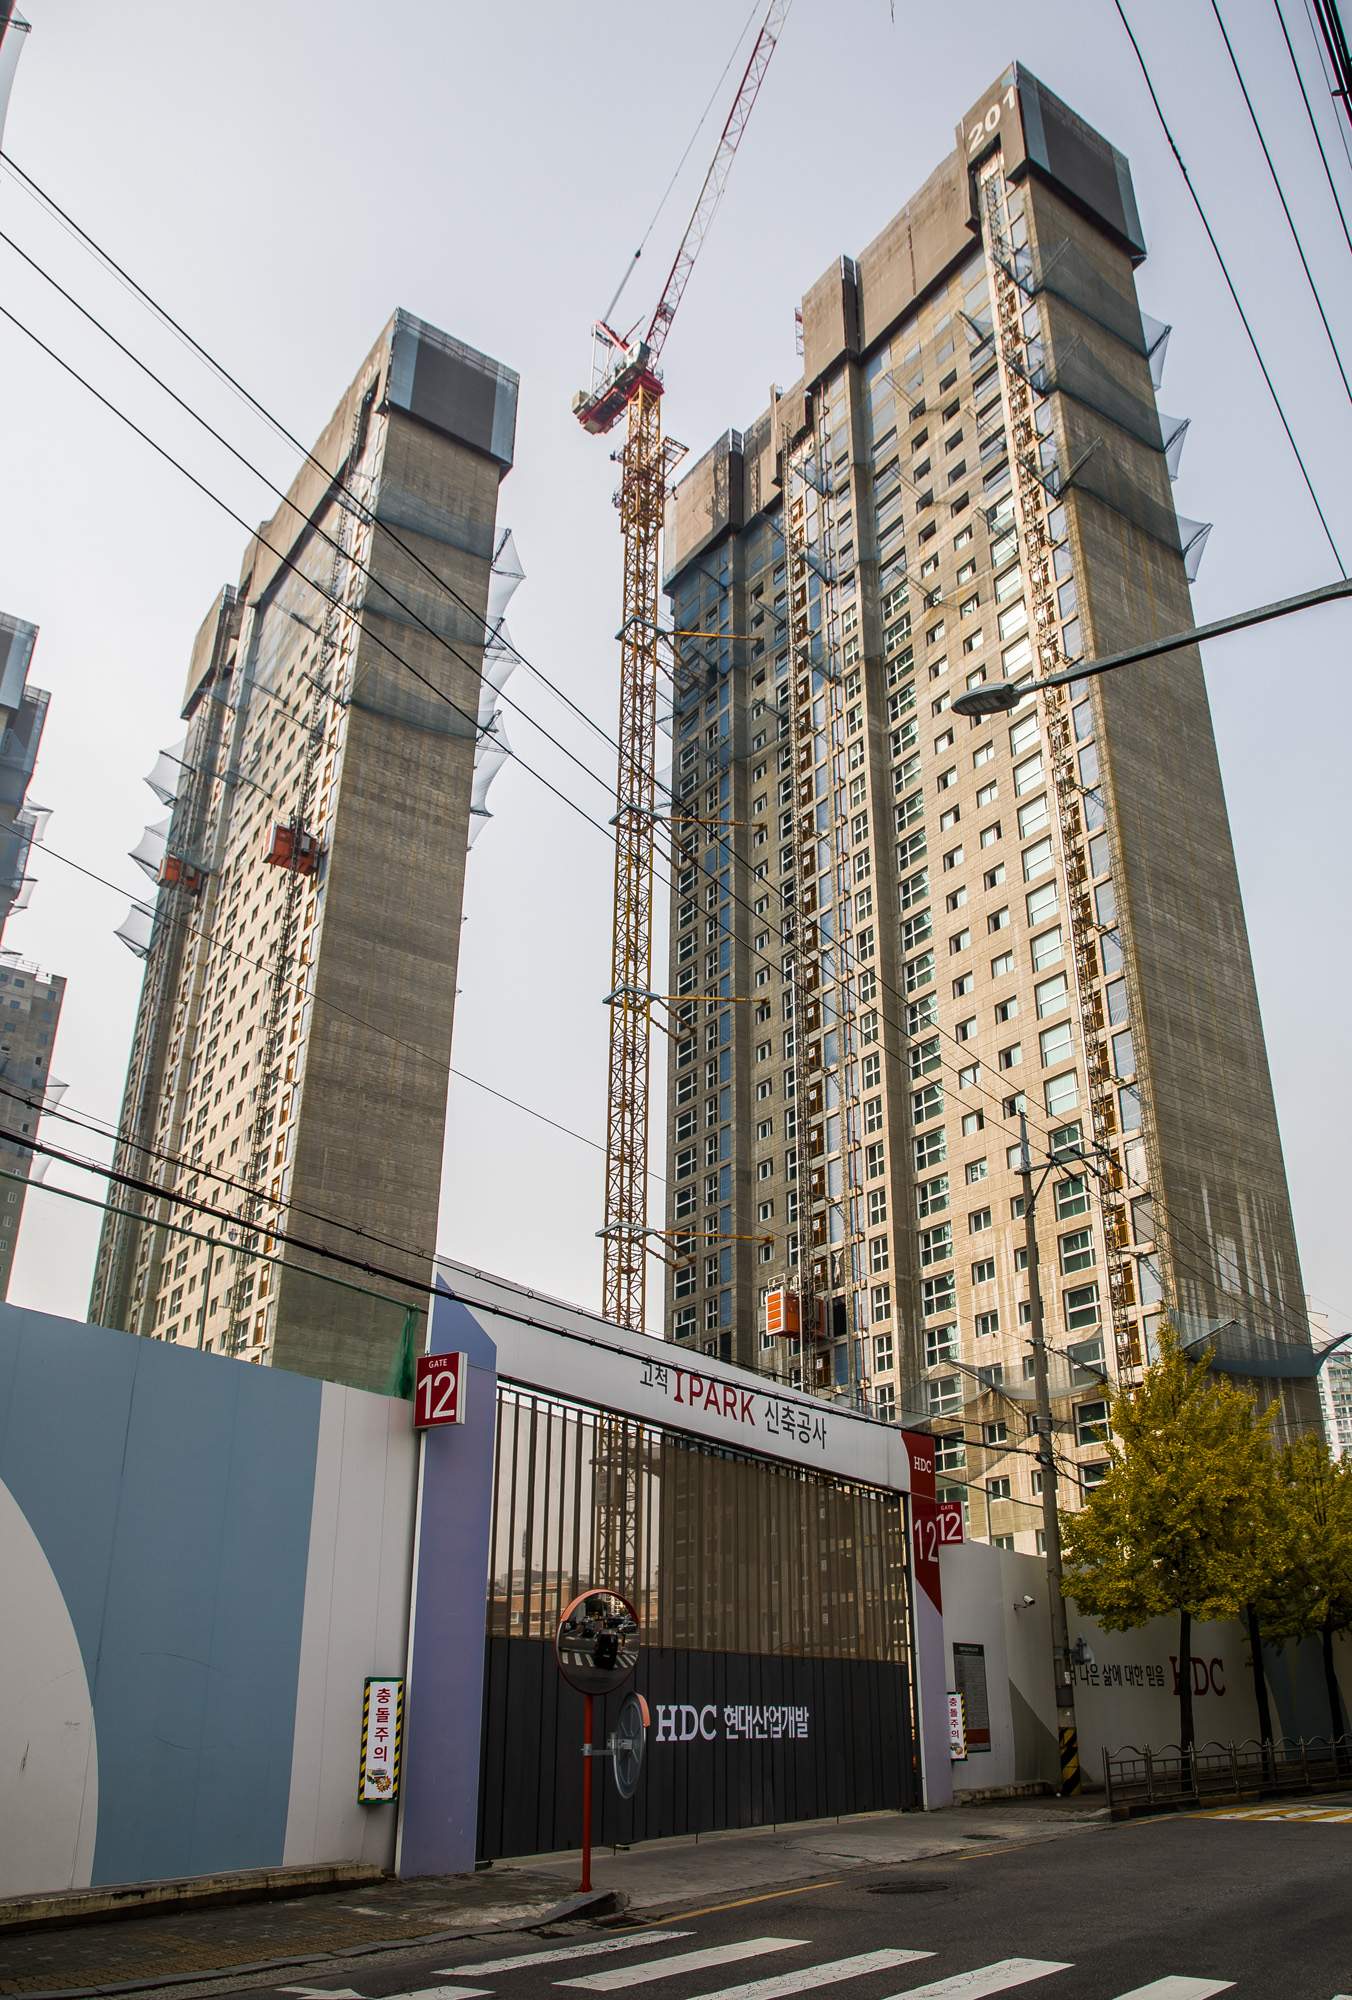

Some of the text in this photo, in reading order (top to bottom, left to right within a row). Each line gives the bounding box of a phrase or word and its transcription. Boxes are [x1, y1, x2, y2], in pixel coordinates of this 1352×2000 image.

[967, 85, 1015, 154] 201
[428, 1358, 448, 1369] GATE
[418, 1370, 456, 1419] 12
[640, 1360, 827, 1449] 고척 IPARK 신축공사
[913, 1456, 932, 1473] HDC
[914, 1519, 938, 1563] 12
[936, 1512, 962, 1541] 12
[1080, 1664, 1100, 1687] 나은
[1102, 1664, 1122, 1687] 삶에
[1125, 1664, 1144, 1687] 대한
[1146, 1665, 1165, 1687] 믿음
[373, 1687, 391, 1762] 충돌주의
[656, 1704, 809, 1742] HDC 현대산업개발
[949, 1697, 960, 1739] 충돌주의
